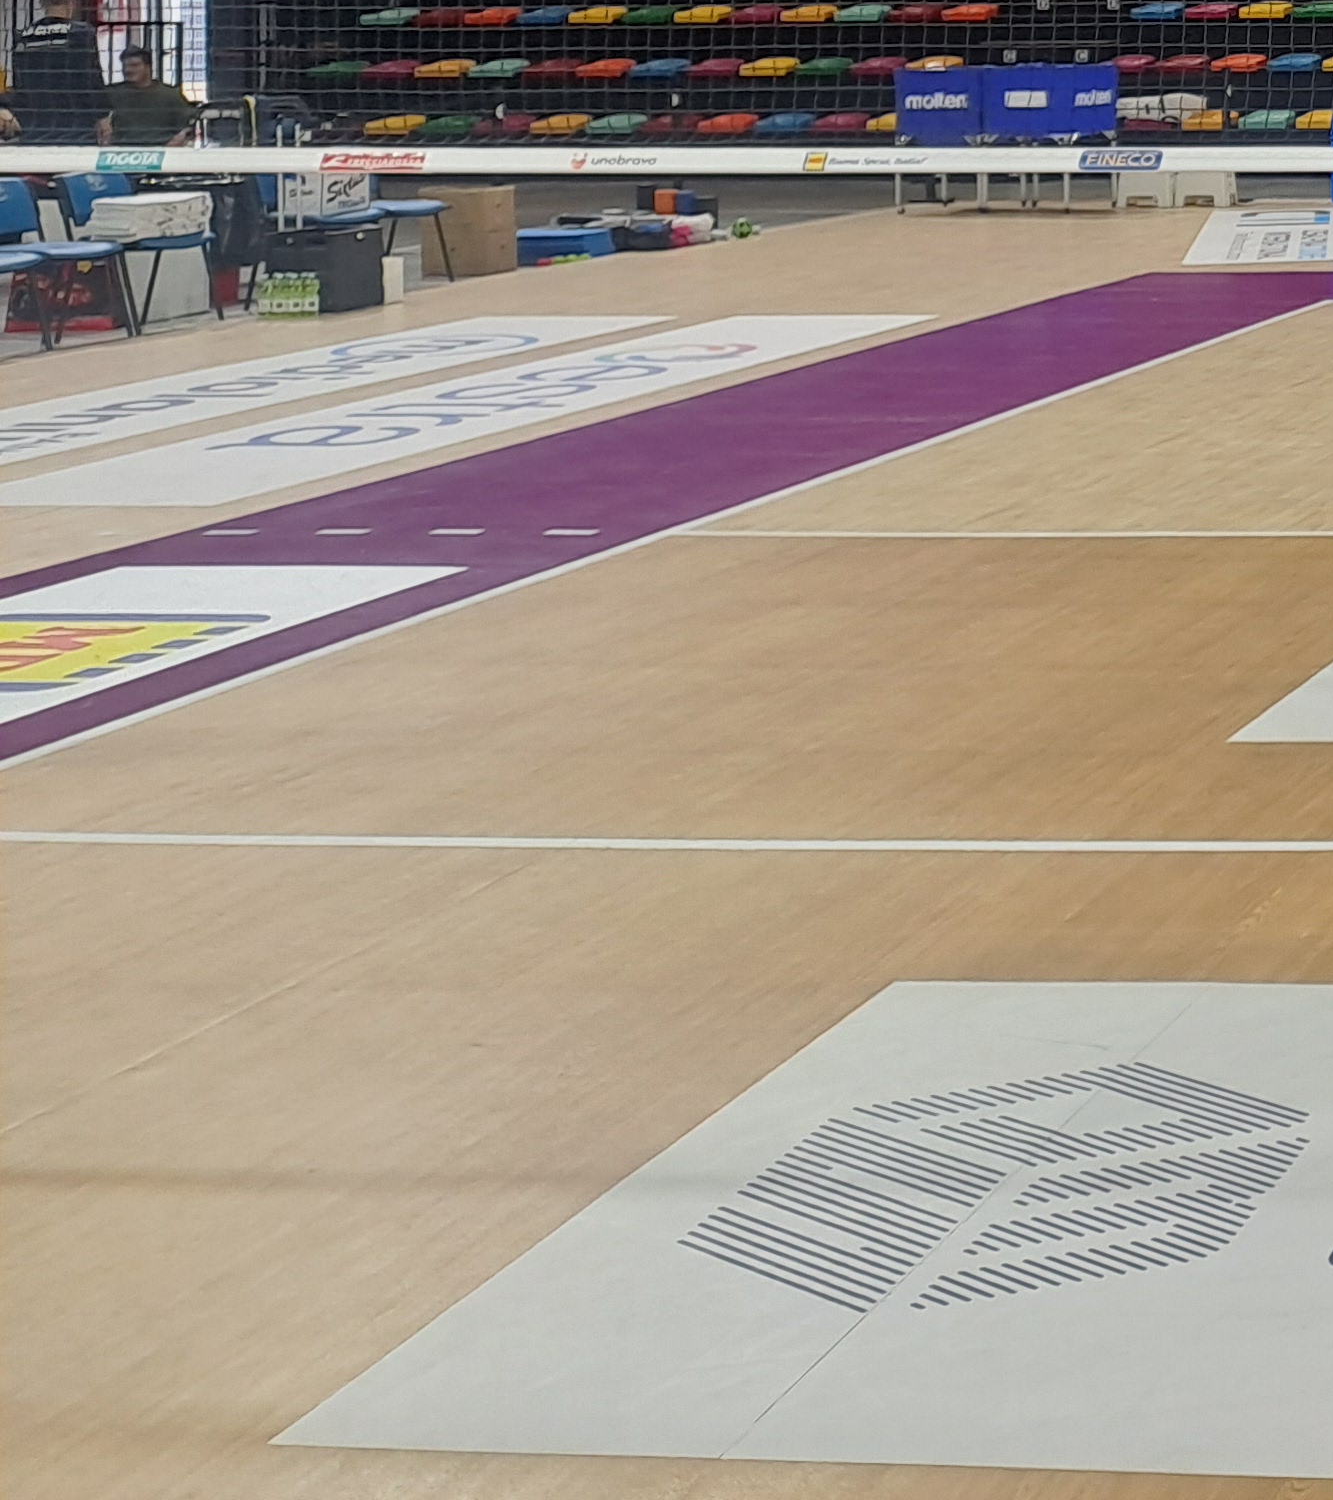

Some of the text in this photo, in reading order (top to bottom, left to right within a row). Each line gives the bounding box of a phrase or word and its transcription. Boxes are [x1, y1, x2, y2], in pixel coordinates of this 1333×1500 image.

[904, 90, 968, 110] molten
[1073, 89, 1113, 107] molten
[590, 154, 657, 166] unobravo
[1085, 150, 1157, 167] FINECO
